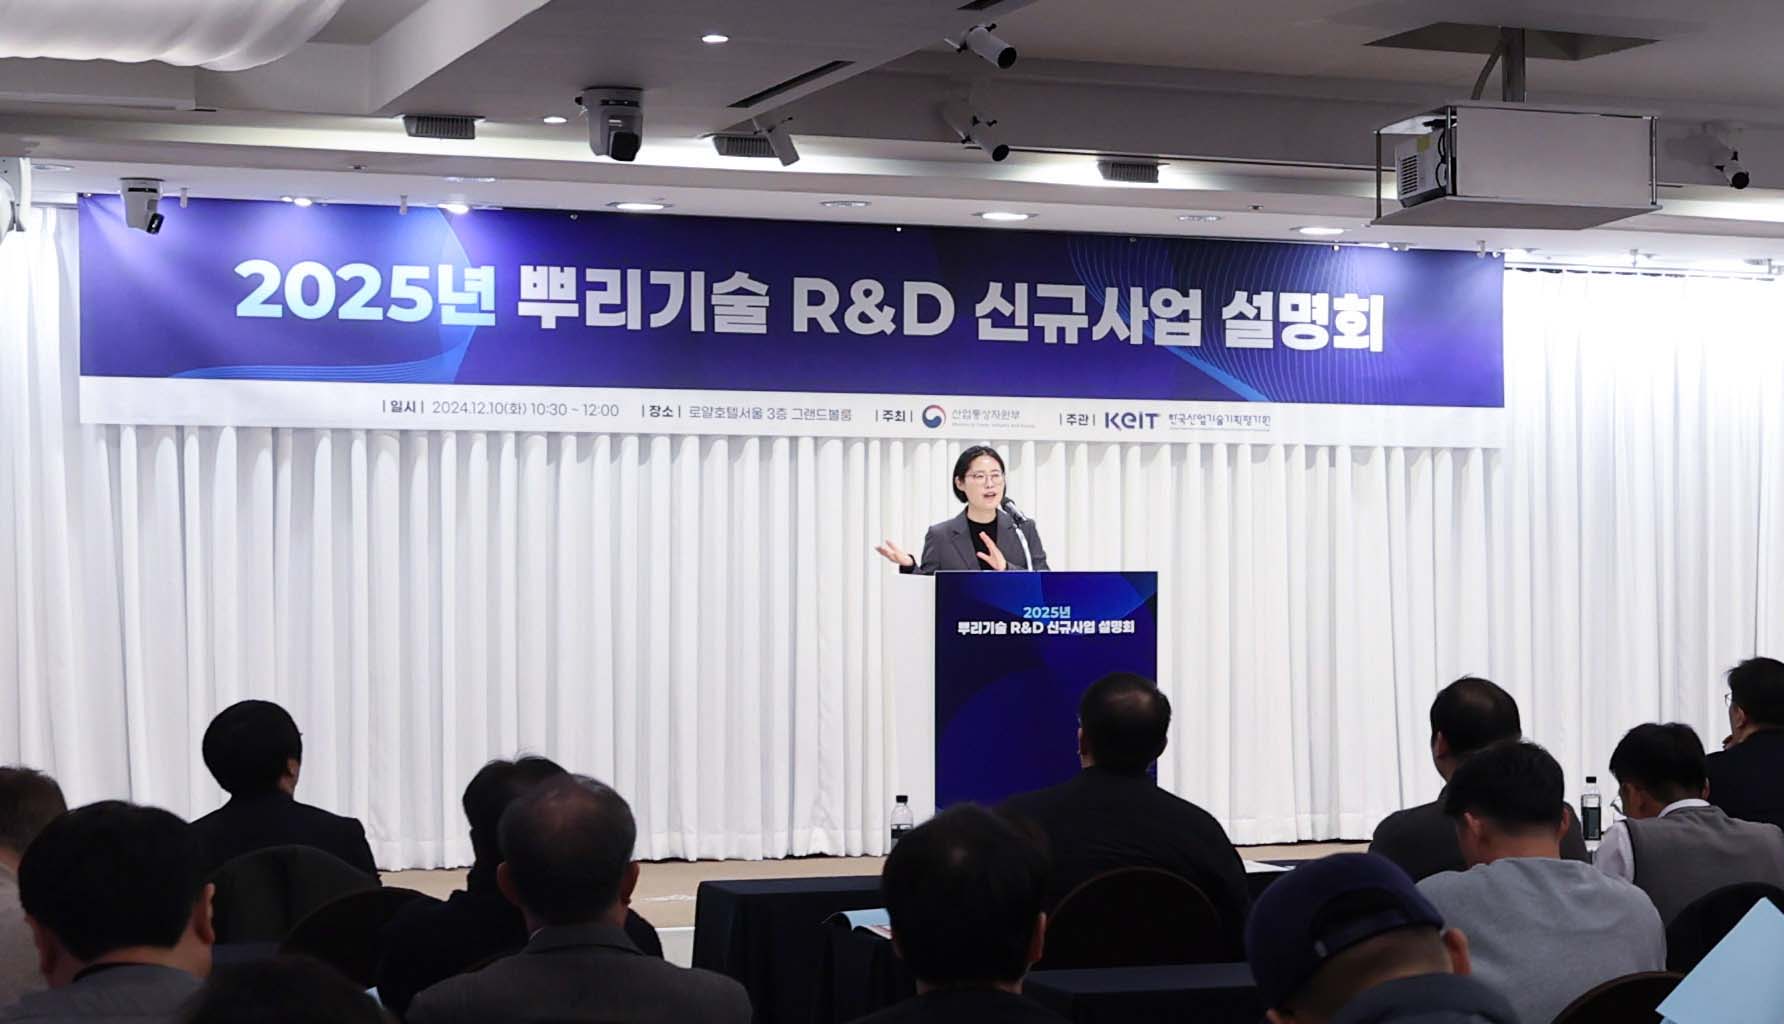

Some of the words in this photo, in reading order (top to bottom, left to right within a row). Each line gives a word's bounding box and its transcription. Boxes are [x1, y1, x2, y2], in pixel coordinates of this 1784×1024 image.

[233, 259, 496, 326] 2025년
[518, 265, 769, 333] 뿌리기술
[793, 277, 955, 336] R&D
[975, 283, 1201, 346] 신규사업
[1222, 290, 1383, 352] 설명회
[433, 401, 527, 415] 2024.12.10(화)
[531, 403, 567, 416] 10:30
[584, 403, 619, 416] 12:00
[690, 406, 763, 419] 로얄호텔서울
[767, 408, 787, 420] 3층
[792, 408, 851, 421] 그랜드볼룸
[1023, 606, 1070, 618] 2025년
[1011, 621, 1044, 634] R&D
[1047, 621, 1095, 634] 신규사업
[1098, 620, 1135, 633] 설명회
